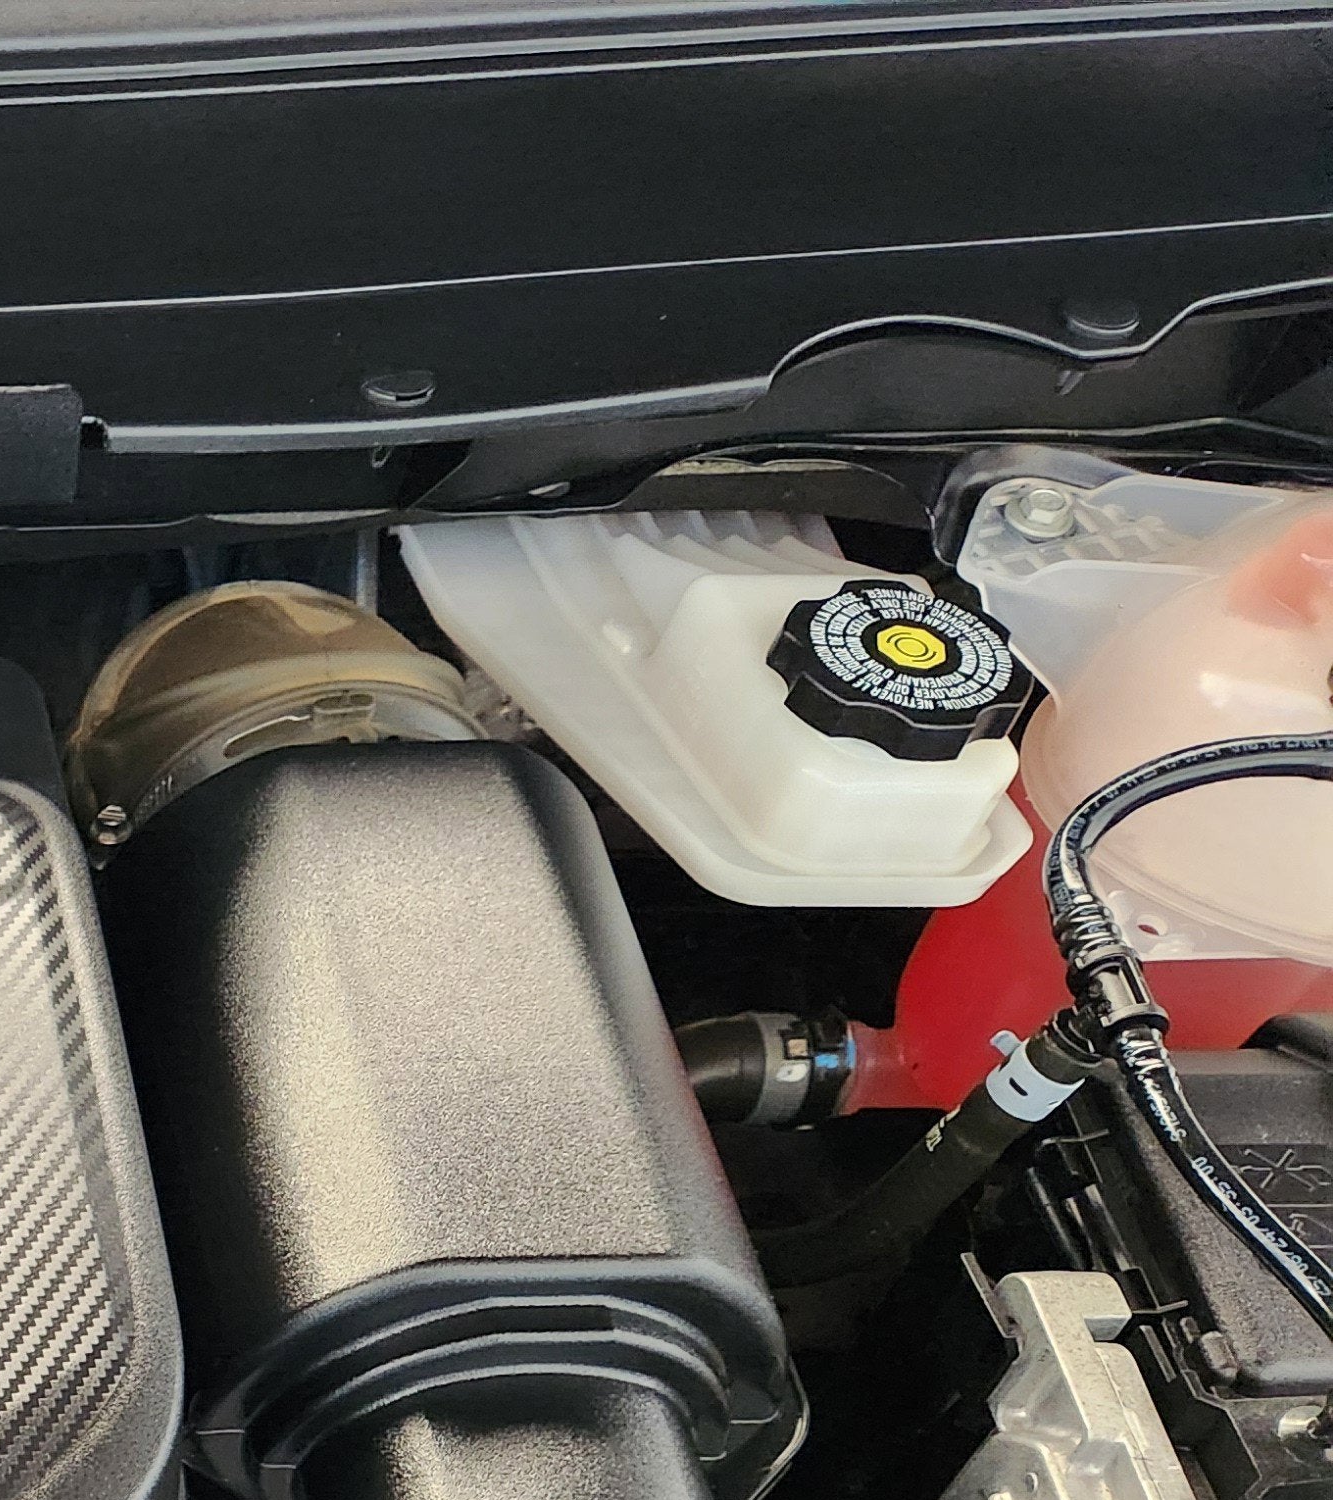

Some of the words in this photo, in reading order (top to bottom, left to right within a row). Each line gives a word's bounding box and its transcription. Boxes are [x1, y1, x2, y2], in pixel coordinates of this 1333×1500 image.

[866, 598, 901, 609] ONLY
[901, 599, 926, 612] USE
[932, 597, 980, 624] SEALED
[876, 608, 923, 622] FILLER
[921, 614, 963, 638] CLEAN
[976, 625, 1007, 649] FROM
[812, 645, 857, 682] BOUCHON
[830, 646, 868, 676] LIQUIDE
[849, 678, 872, 692] LE
[861, 671, 884, 686] DU
[883, 679, 909, 696] QUE
[893, 669, 967, 688] PROVENANT
[867, 685, 936, 710] NETTOYER
